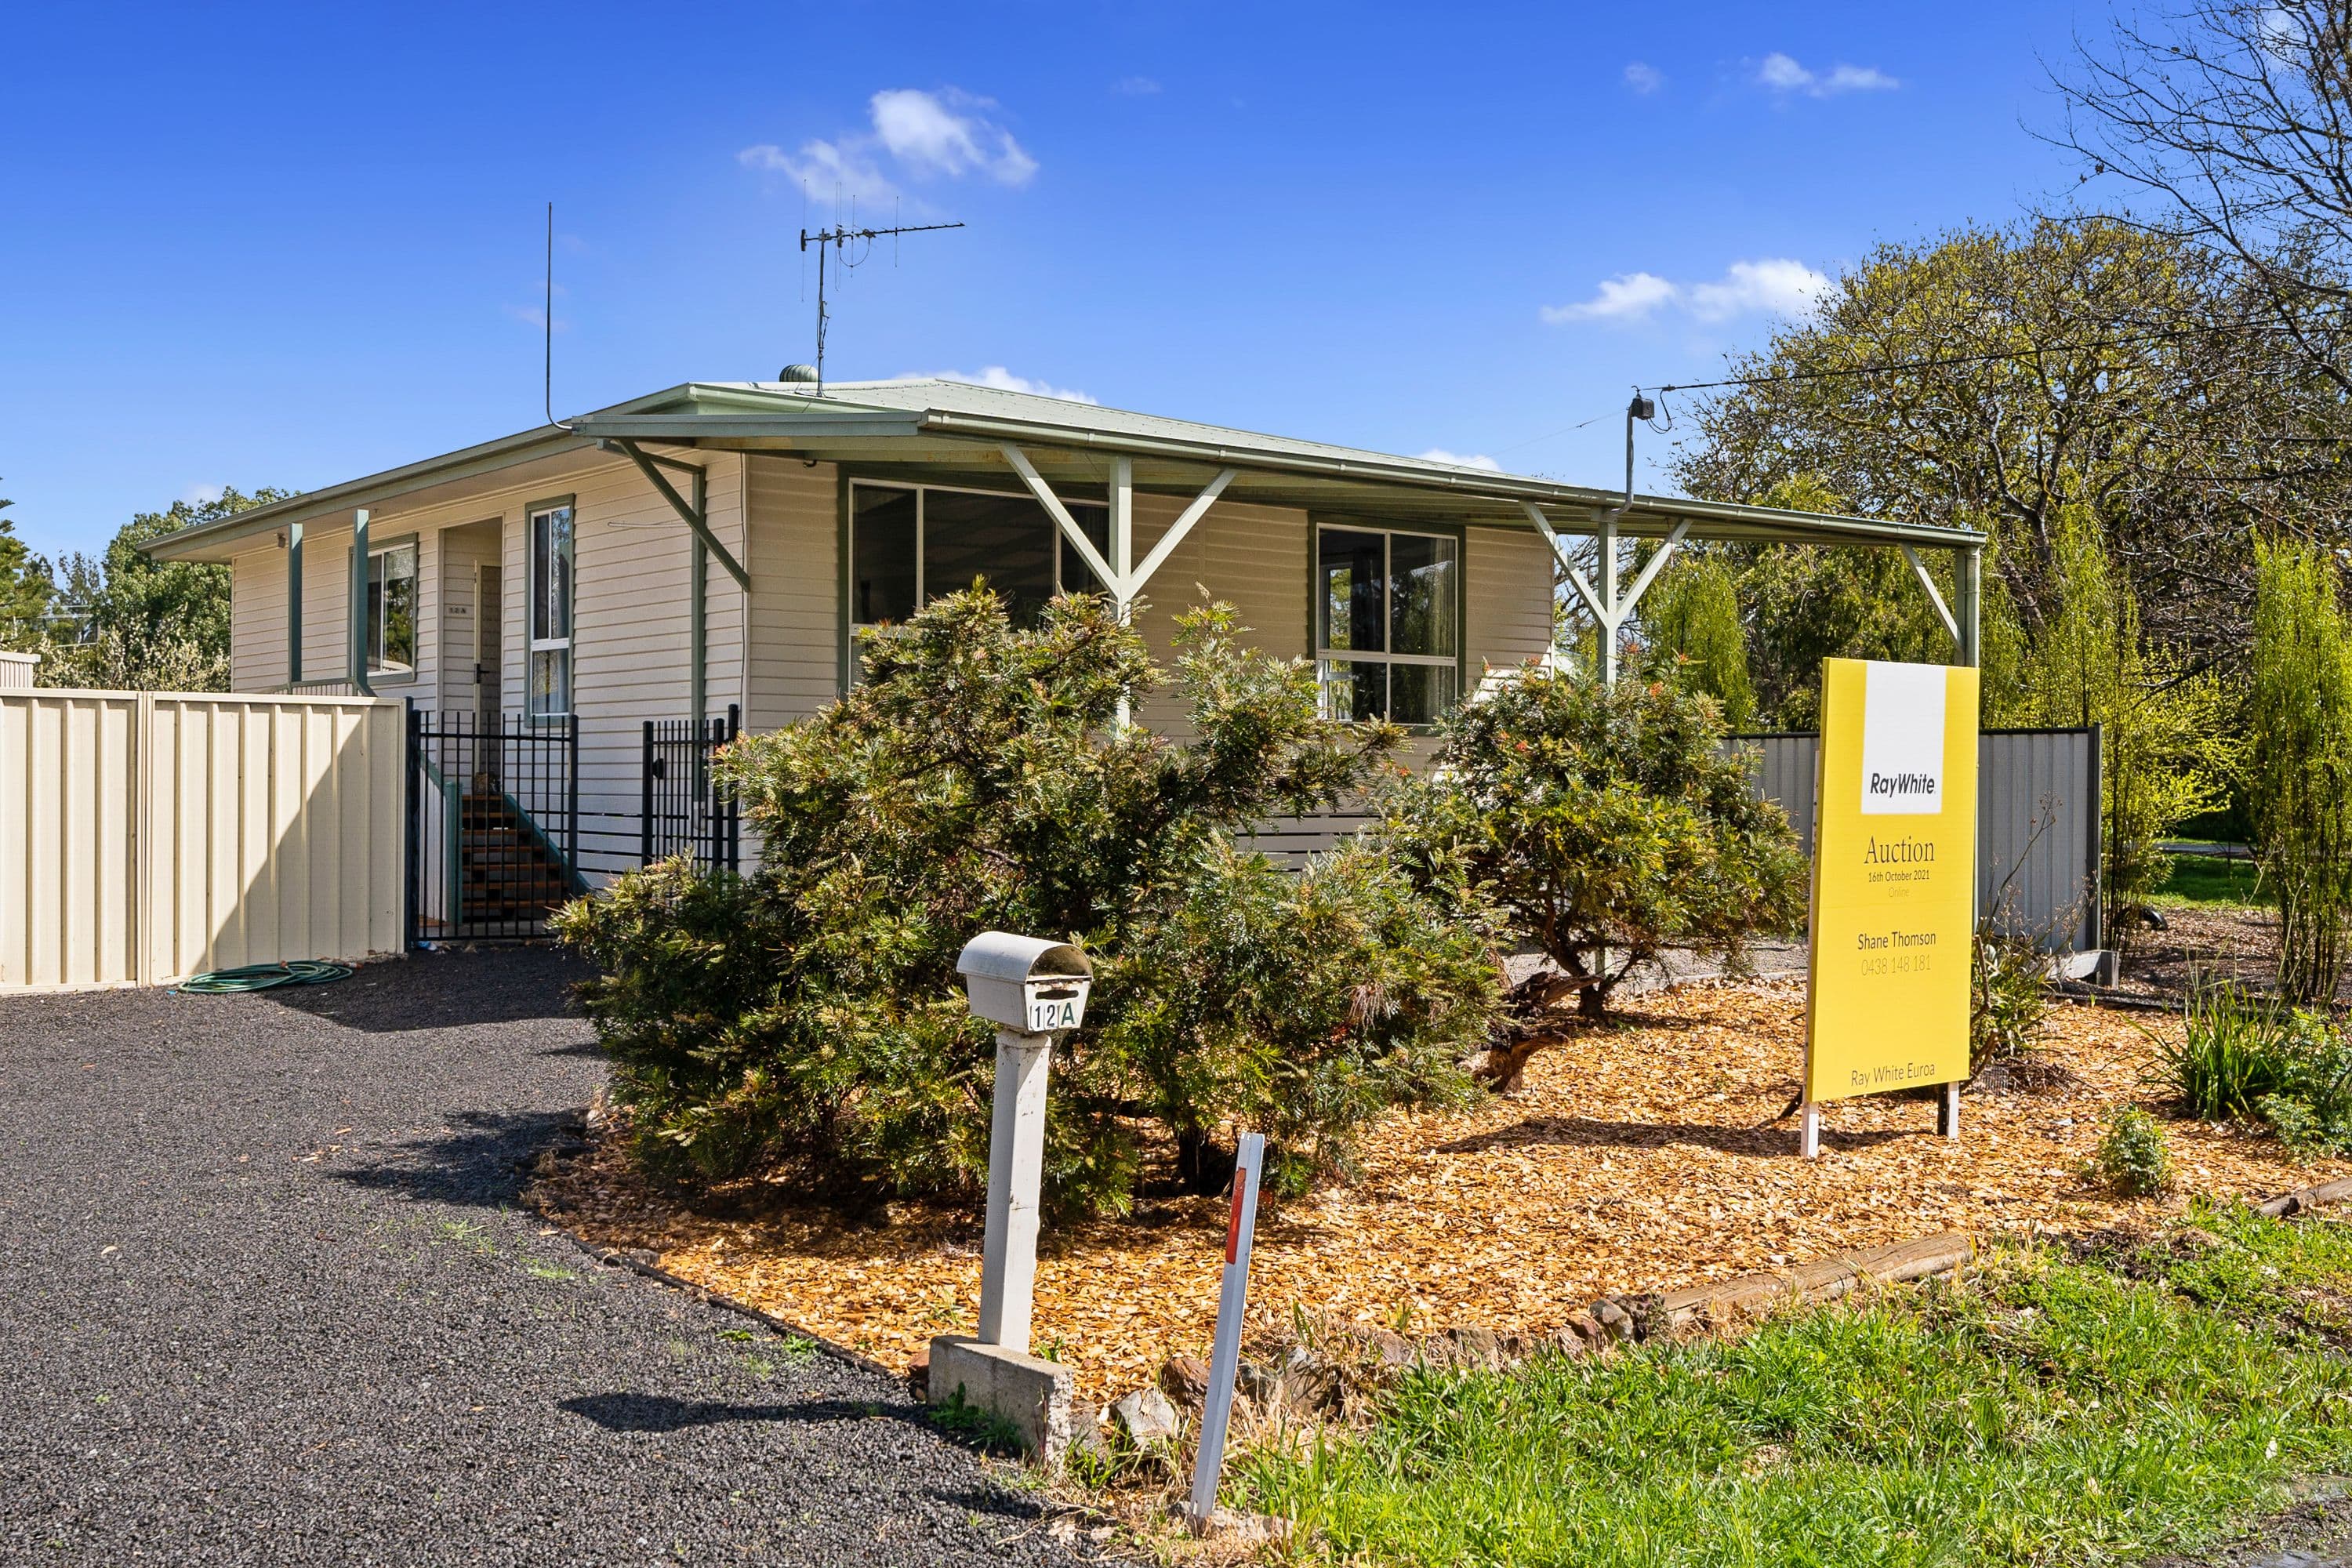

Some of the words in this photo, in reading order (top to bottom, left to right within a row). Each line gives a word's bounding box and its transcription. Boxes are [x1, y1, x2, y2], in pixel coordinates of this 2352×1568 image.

[1870, 772, 1935, 797] RayWhite
[1864, 835, 1934, 864] Auction
[1868, 872, 1883, 883] 16th
[1885, 871, 1911, 882] October
[1914, 869, 1929, 880] 2021
[1888, 887, 1910, 898] Online
[1857, 934, 1889, 950] Shane
[1891, 931, 1936, 948] Thomson
[1861, 958, 1888, 976] 0438
[1891, 956, 1910, 974] 148
[1913, 954, 1931, 971] 181
[1035, 1002, 1075, 1028] 12A
[1851, 1070, 1870, 1087] Ray
[1873, 1065, 1904, 1083] White
[1907, 1062, 1935, 1078] Euroa
